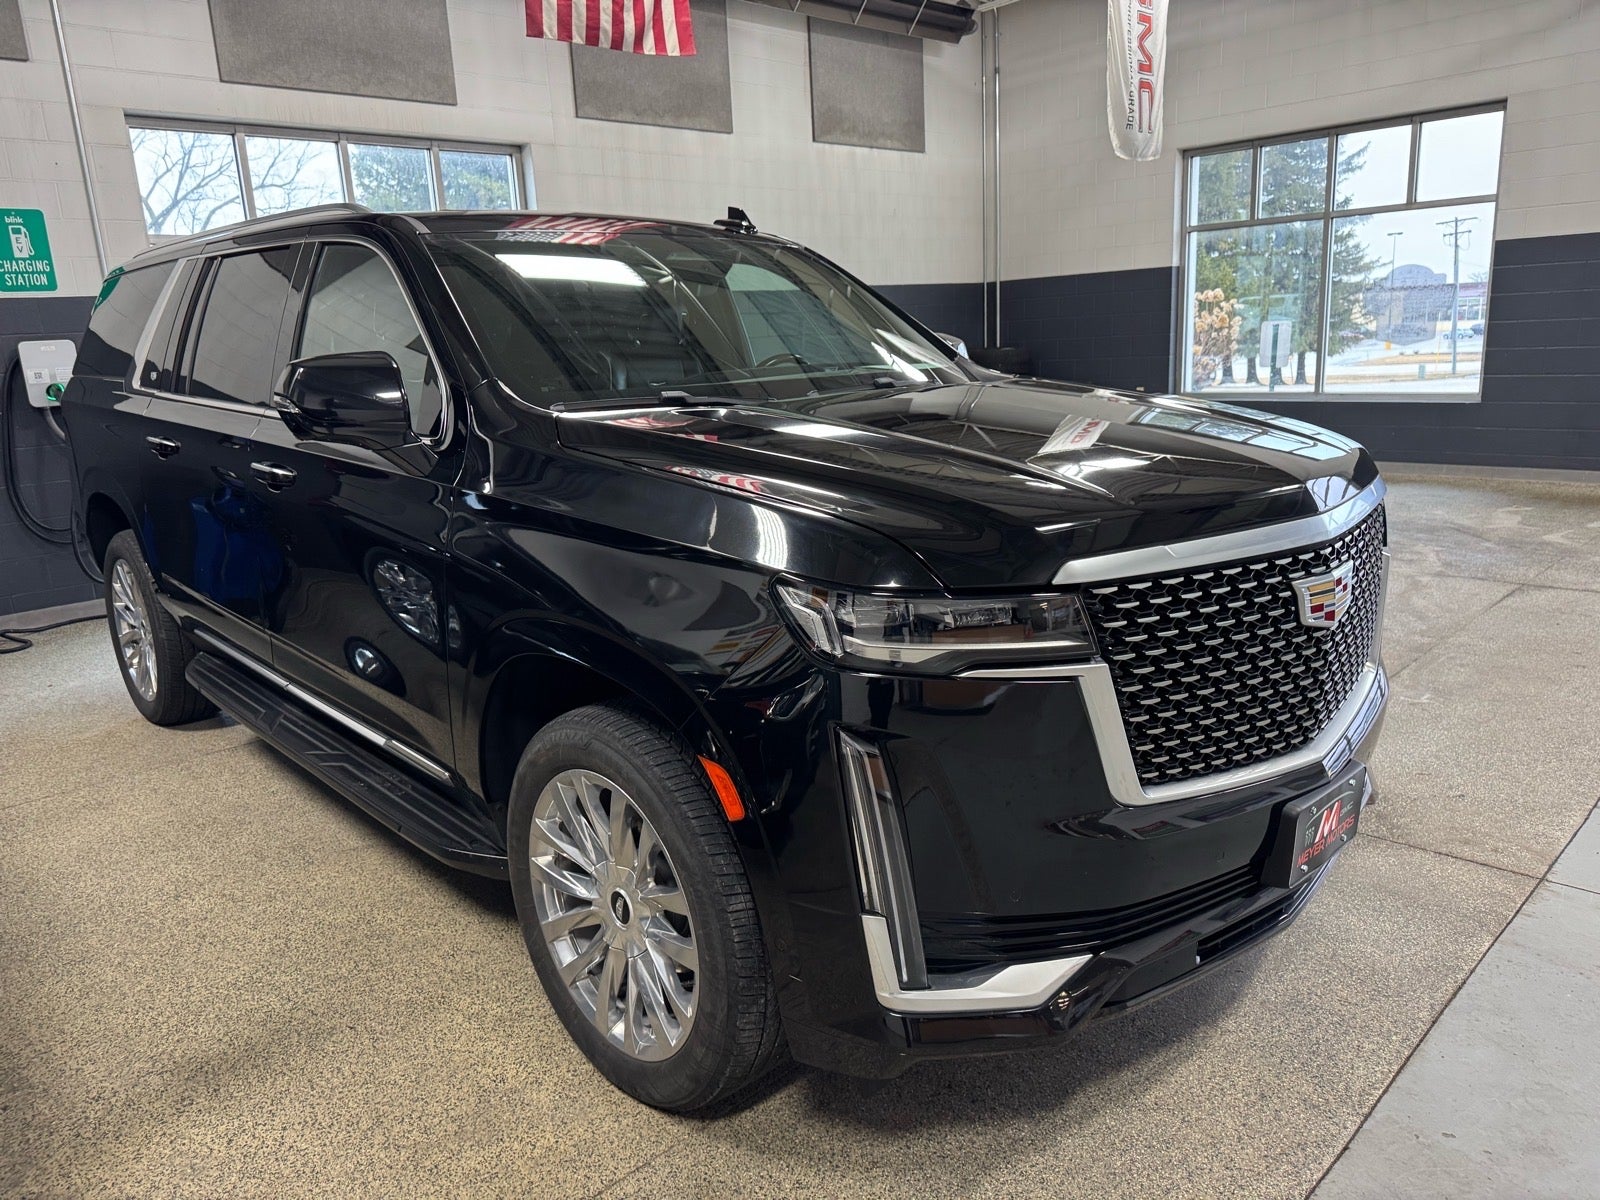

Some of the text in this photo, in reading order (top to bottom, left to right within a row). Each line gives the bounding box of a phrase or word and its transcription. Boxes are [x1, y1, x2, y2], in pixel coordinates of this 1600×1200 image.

[1137, 0, 1154, 133] MC
[1126, 91, 1135, 130] GRADE
[4, 216, 24, 224] blink
[0, 260, 50, 272] CHARGING
[4, 274, 48, 287] STATION
[1297, 814, 1355, 868] MEYER MOTORS
